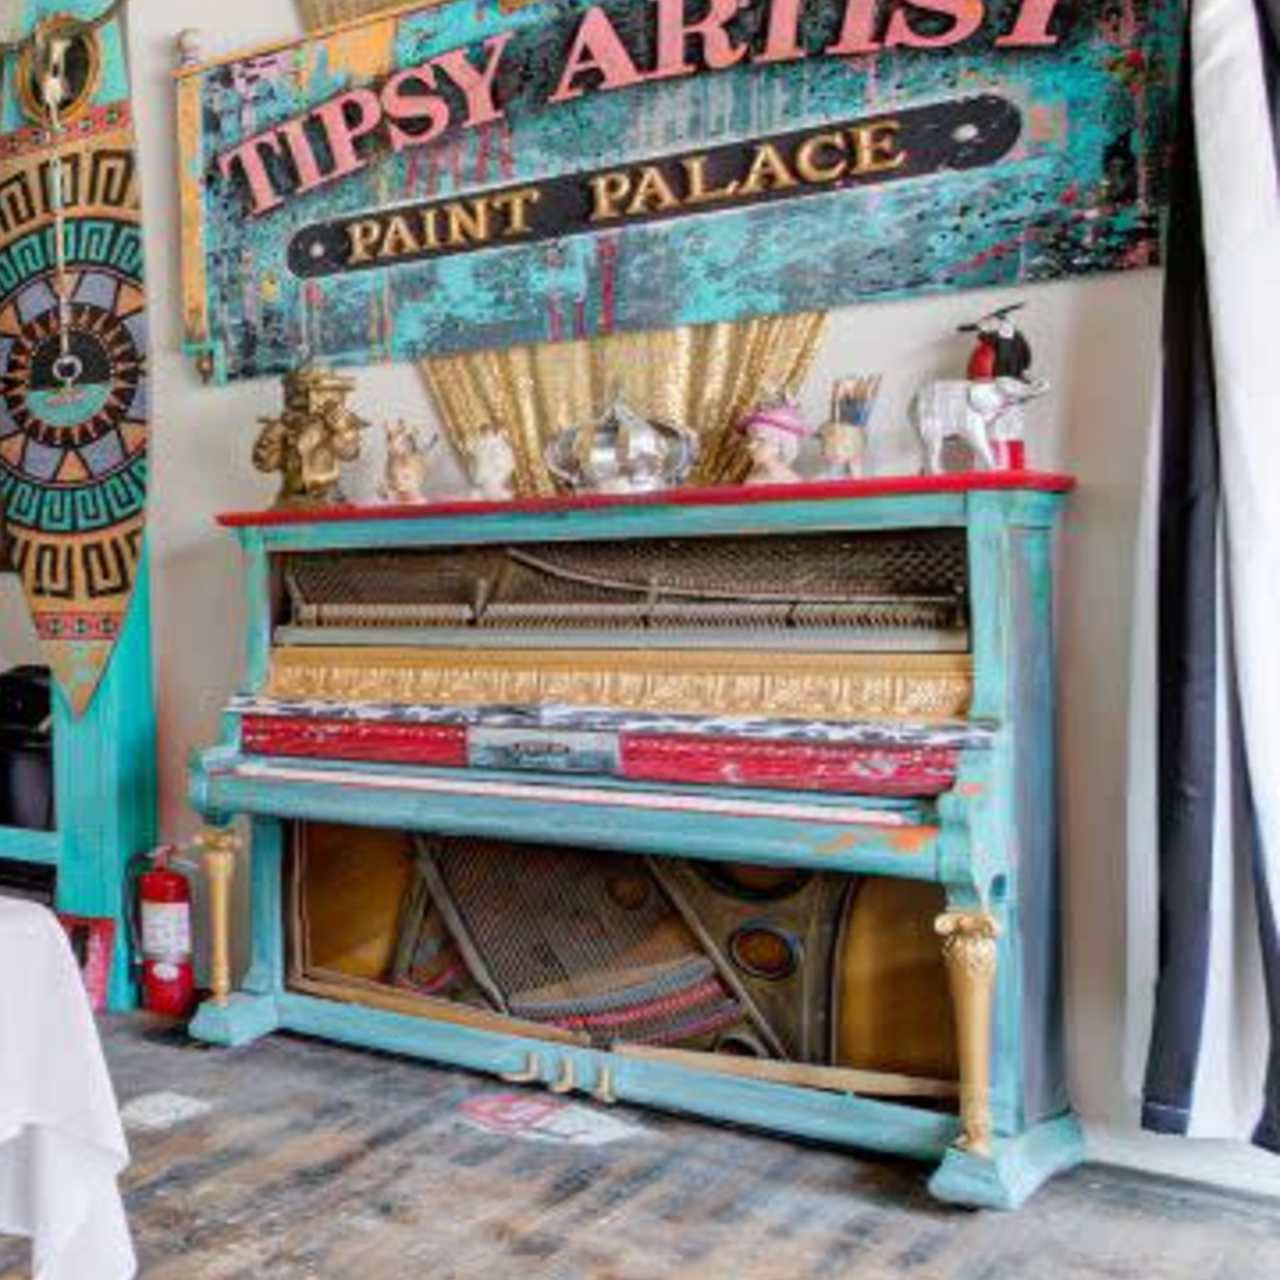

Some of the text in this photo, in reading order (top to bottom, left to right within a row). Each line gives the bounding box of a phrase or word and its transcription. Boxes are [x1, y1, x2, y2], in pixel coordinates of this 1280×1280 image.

[217, 31, 514, 218] TIPSY
[345, 117, 908, 266] PAINT PALACE
